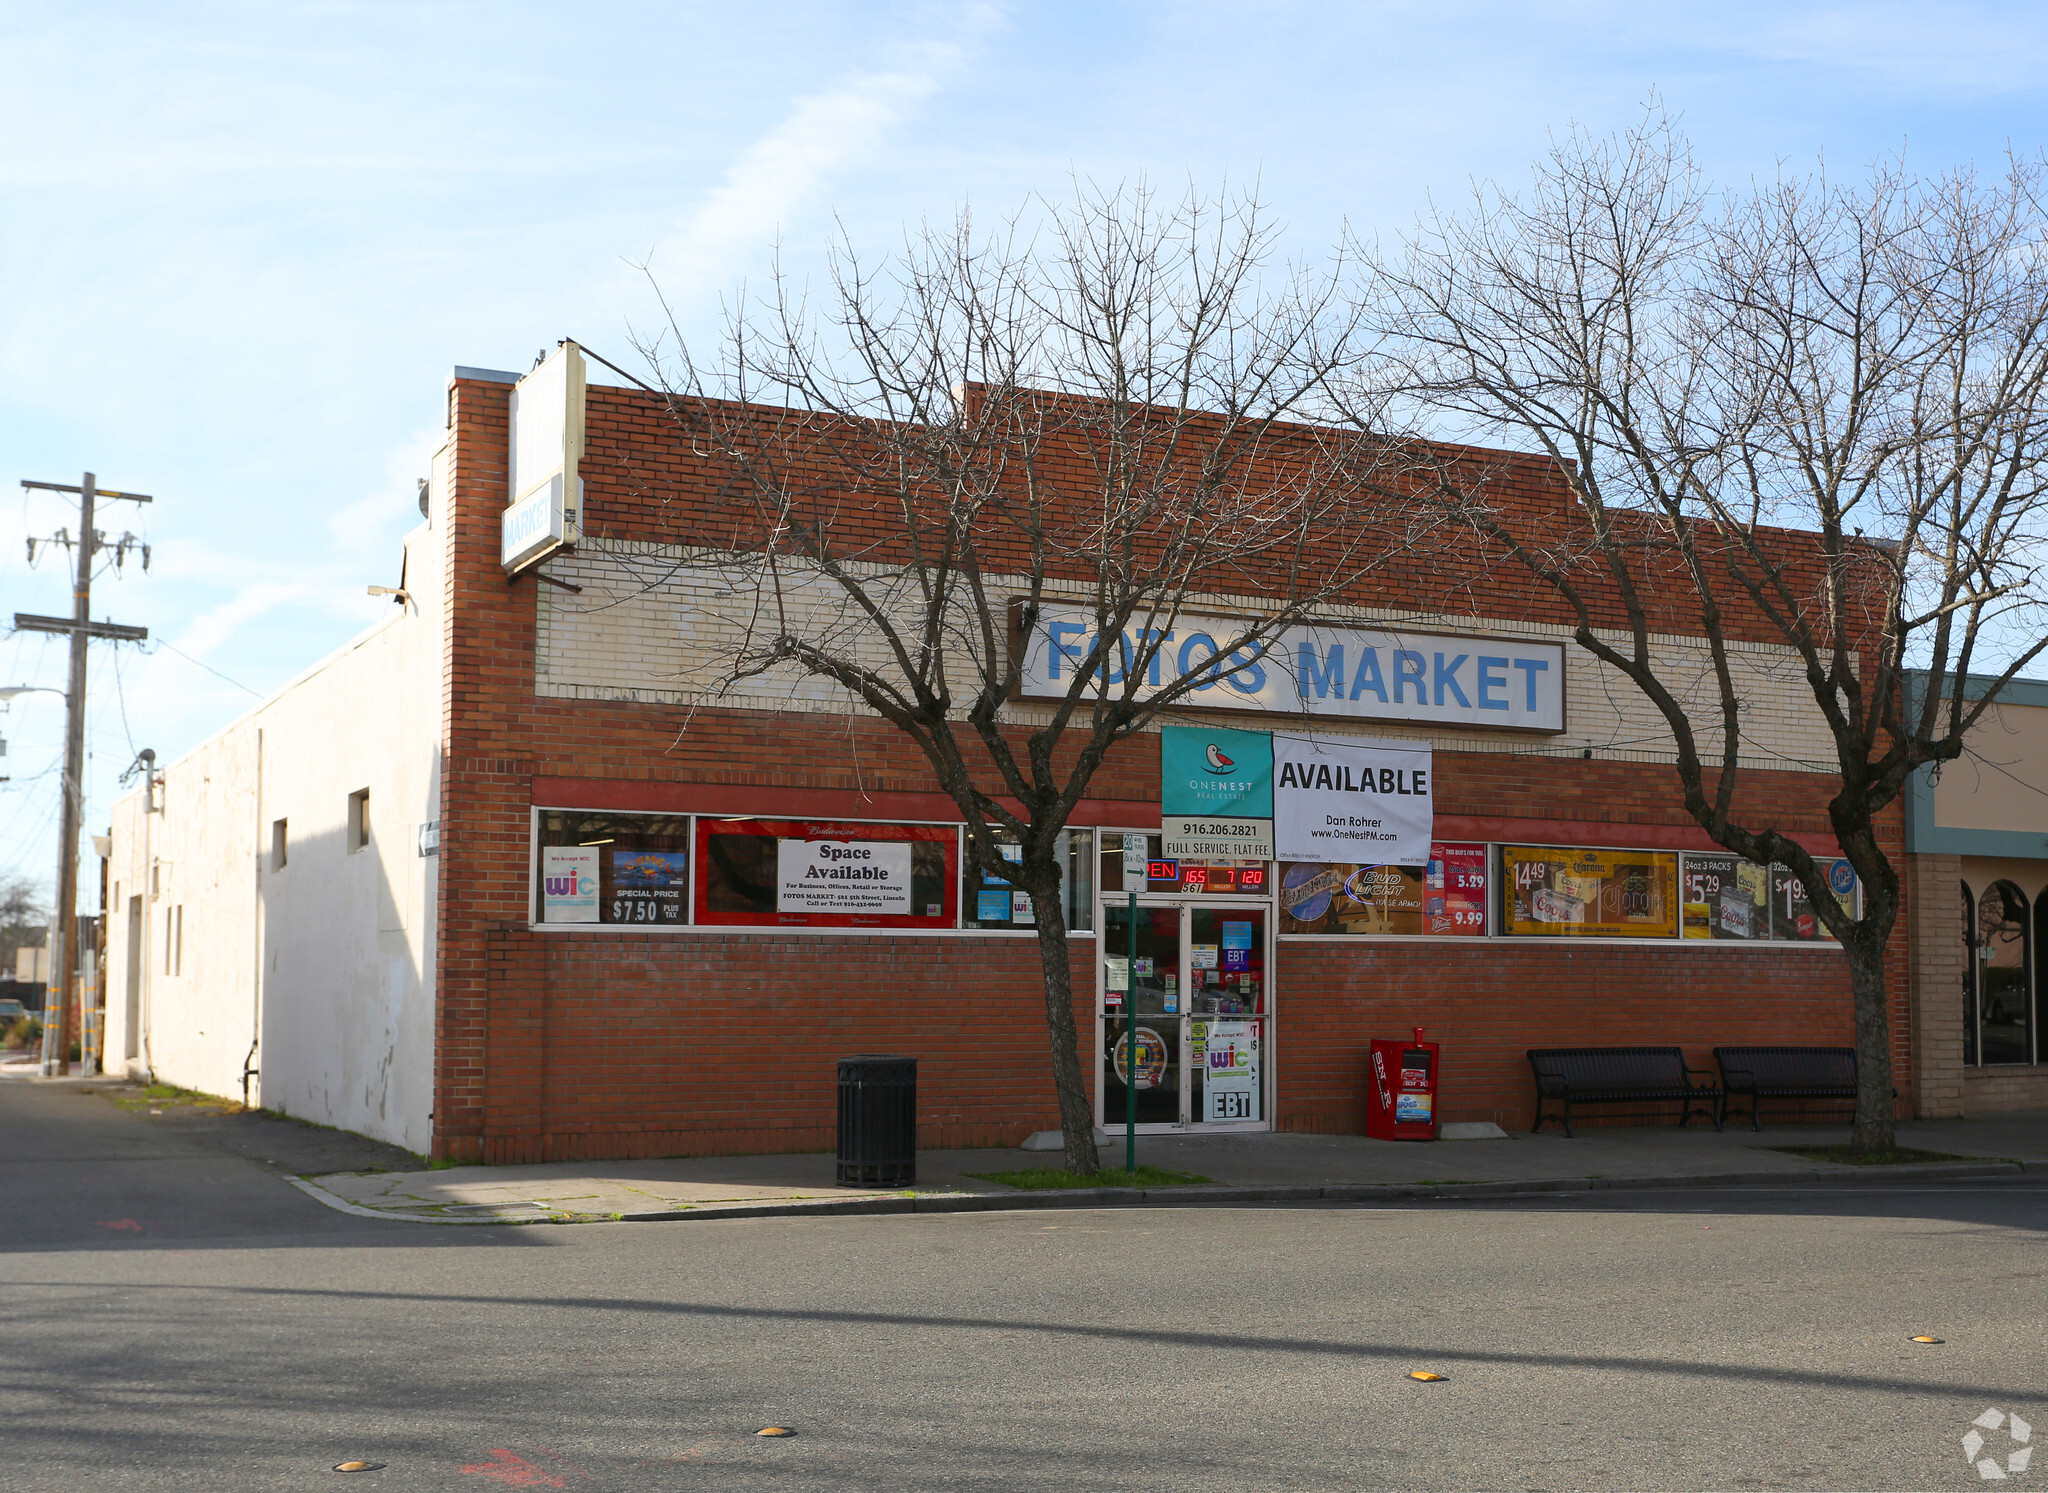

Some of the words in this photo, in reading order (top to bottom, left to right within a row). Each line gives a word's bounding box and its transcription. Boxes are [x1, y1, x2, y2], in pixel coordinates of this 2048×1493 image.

[504, 495, 549, 549] MARKET
[1048, 622, 1268, 695] FOTOS
[1299, 642, 1549, 712] MARKET
[1190, 780, 1252, 791] ONENEST
[1279, 762, 1427, 796] AVAILABLE
[1197, 792, 1215, 800] REAL
[1219, 793, 1246, 801] ESTATE
[1326, 815, 1346, 826] Dan
[1349, 816, 1382, 828] Rohrer
[807, 826, 855, 836] Budweiser
[1183, 823, 1257, 836] 916.206.2821
[1311, 829, 1397, 842] www.OneNestPM.com
[819, 844, 871, 862] Space
[1167, 843, 1190, 854] FULL
[1193, 843, 1232, 855] SERVICE.
[1234, 844, 1252, 855] FLAT
[1255, 845, 1271, 856] FEE.
[625, 856, 672, 873] CAMEL
[1573, 861, 1605, 874] Corona
[1685, 860, 1701, 870] 24oz
[1702, 861, 1708, 870] 3
[1708, 861, 1731, 871] PACKS
[1773, 862, 1789, 871] 32oz
[805, 864, 888, 880] Available
[1185, 870, 1206, 883] 165
[1227, 870, 1235, 883] 7
[1242, 870, 1263, 884] 120
[1363, 871, 1401, 884] BUD
[1182, 883, 1201, 893] 561
[1457, 875, 1484, 888] 5.29
[1738, 875, 1757, 889] Coors
[653, 890, 679, 898] PRICE
[1355, 883, 1406, 896] LIGHT
[663, 904, 680, 912] PLUS
[1536, 895, 1569, 921] Coors
[665, 911, 677, 919] TAX
[1455, 911, 1483, 925] 9.99
[1721, 905, 1745, 926] Coors
[1227, 950, 1245, 962] EBT
[1214, 1093, 1249, 1118] EBT
